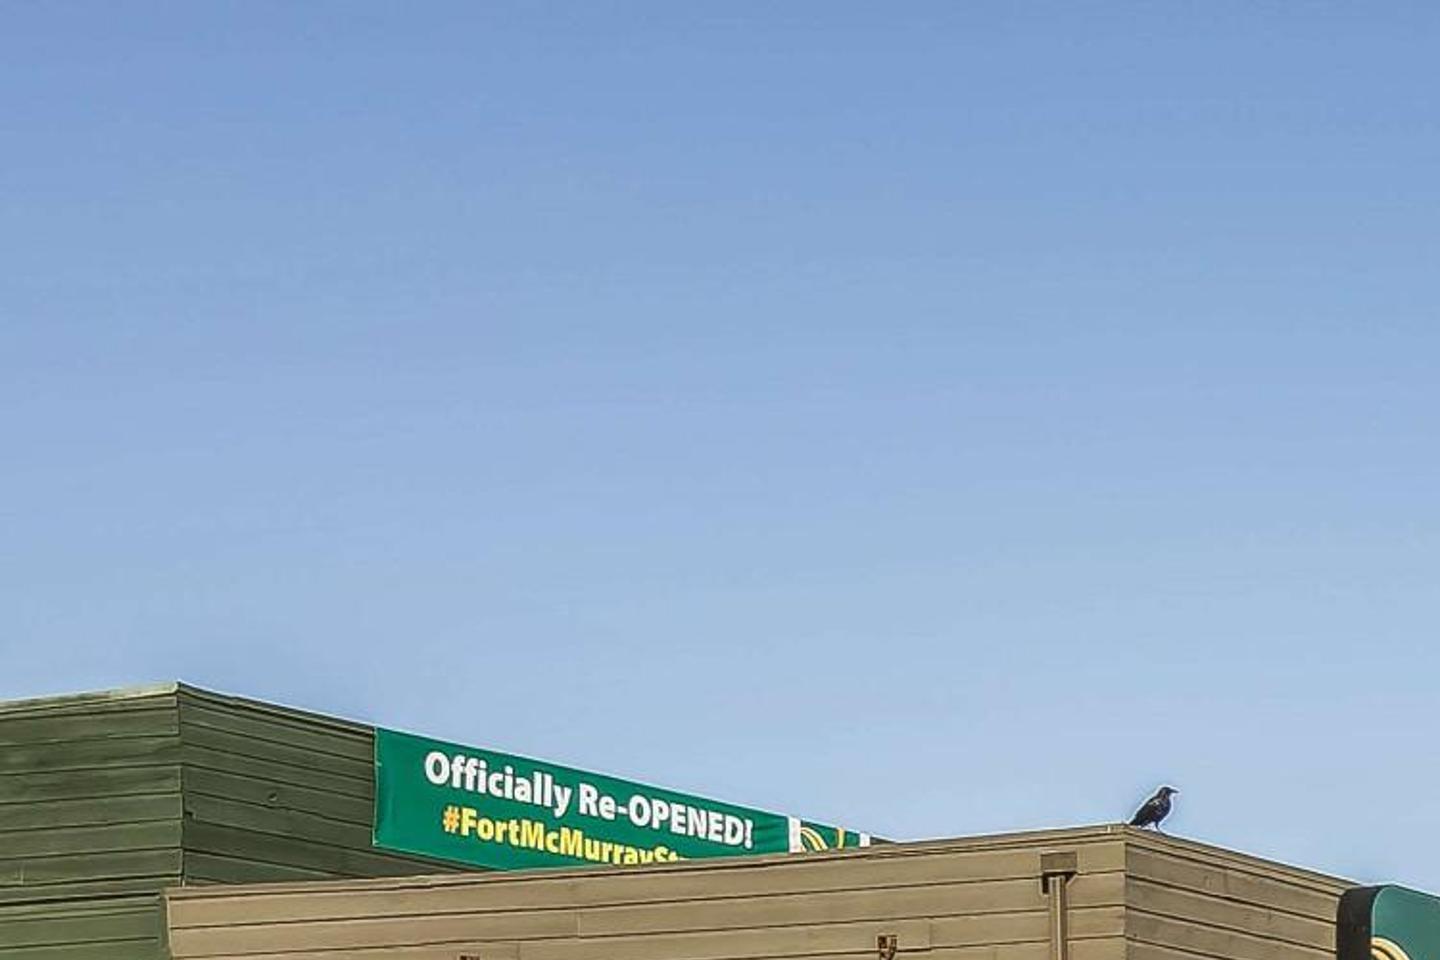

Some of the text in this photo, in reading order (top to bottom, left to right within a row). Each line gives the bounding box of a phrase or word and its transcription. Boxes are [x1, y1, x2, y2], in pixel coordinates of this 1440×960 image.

[424, 751, 754, 849] Officially Re-OPENED!
[442, 805, 690, 866] #FortMcMurraySt
